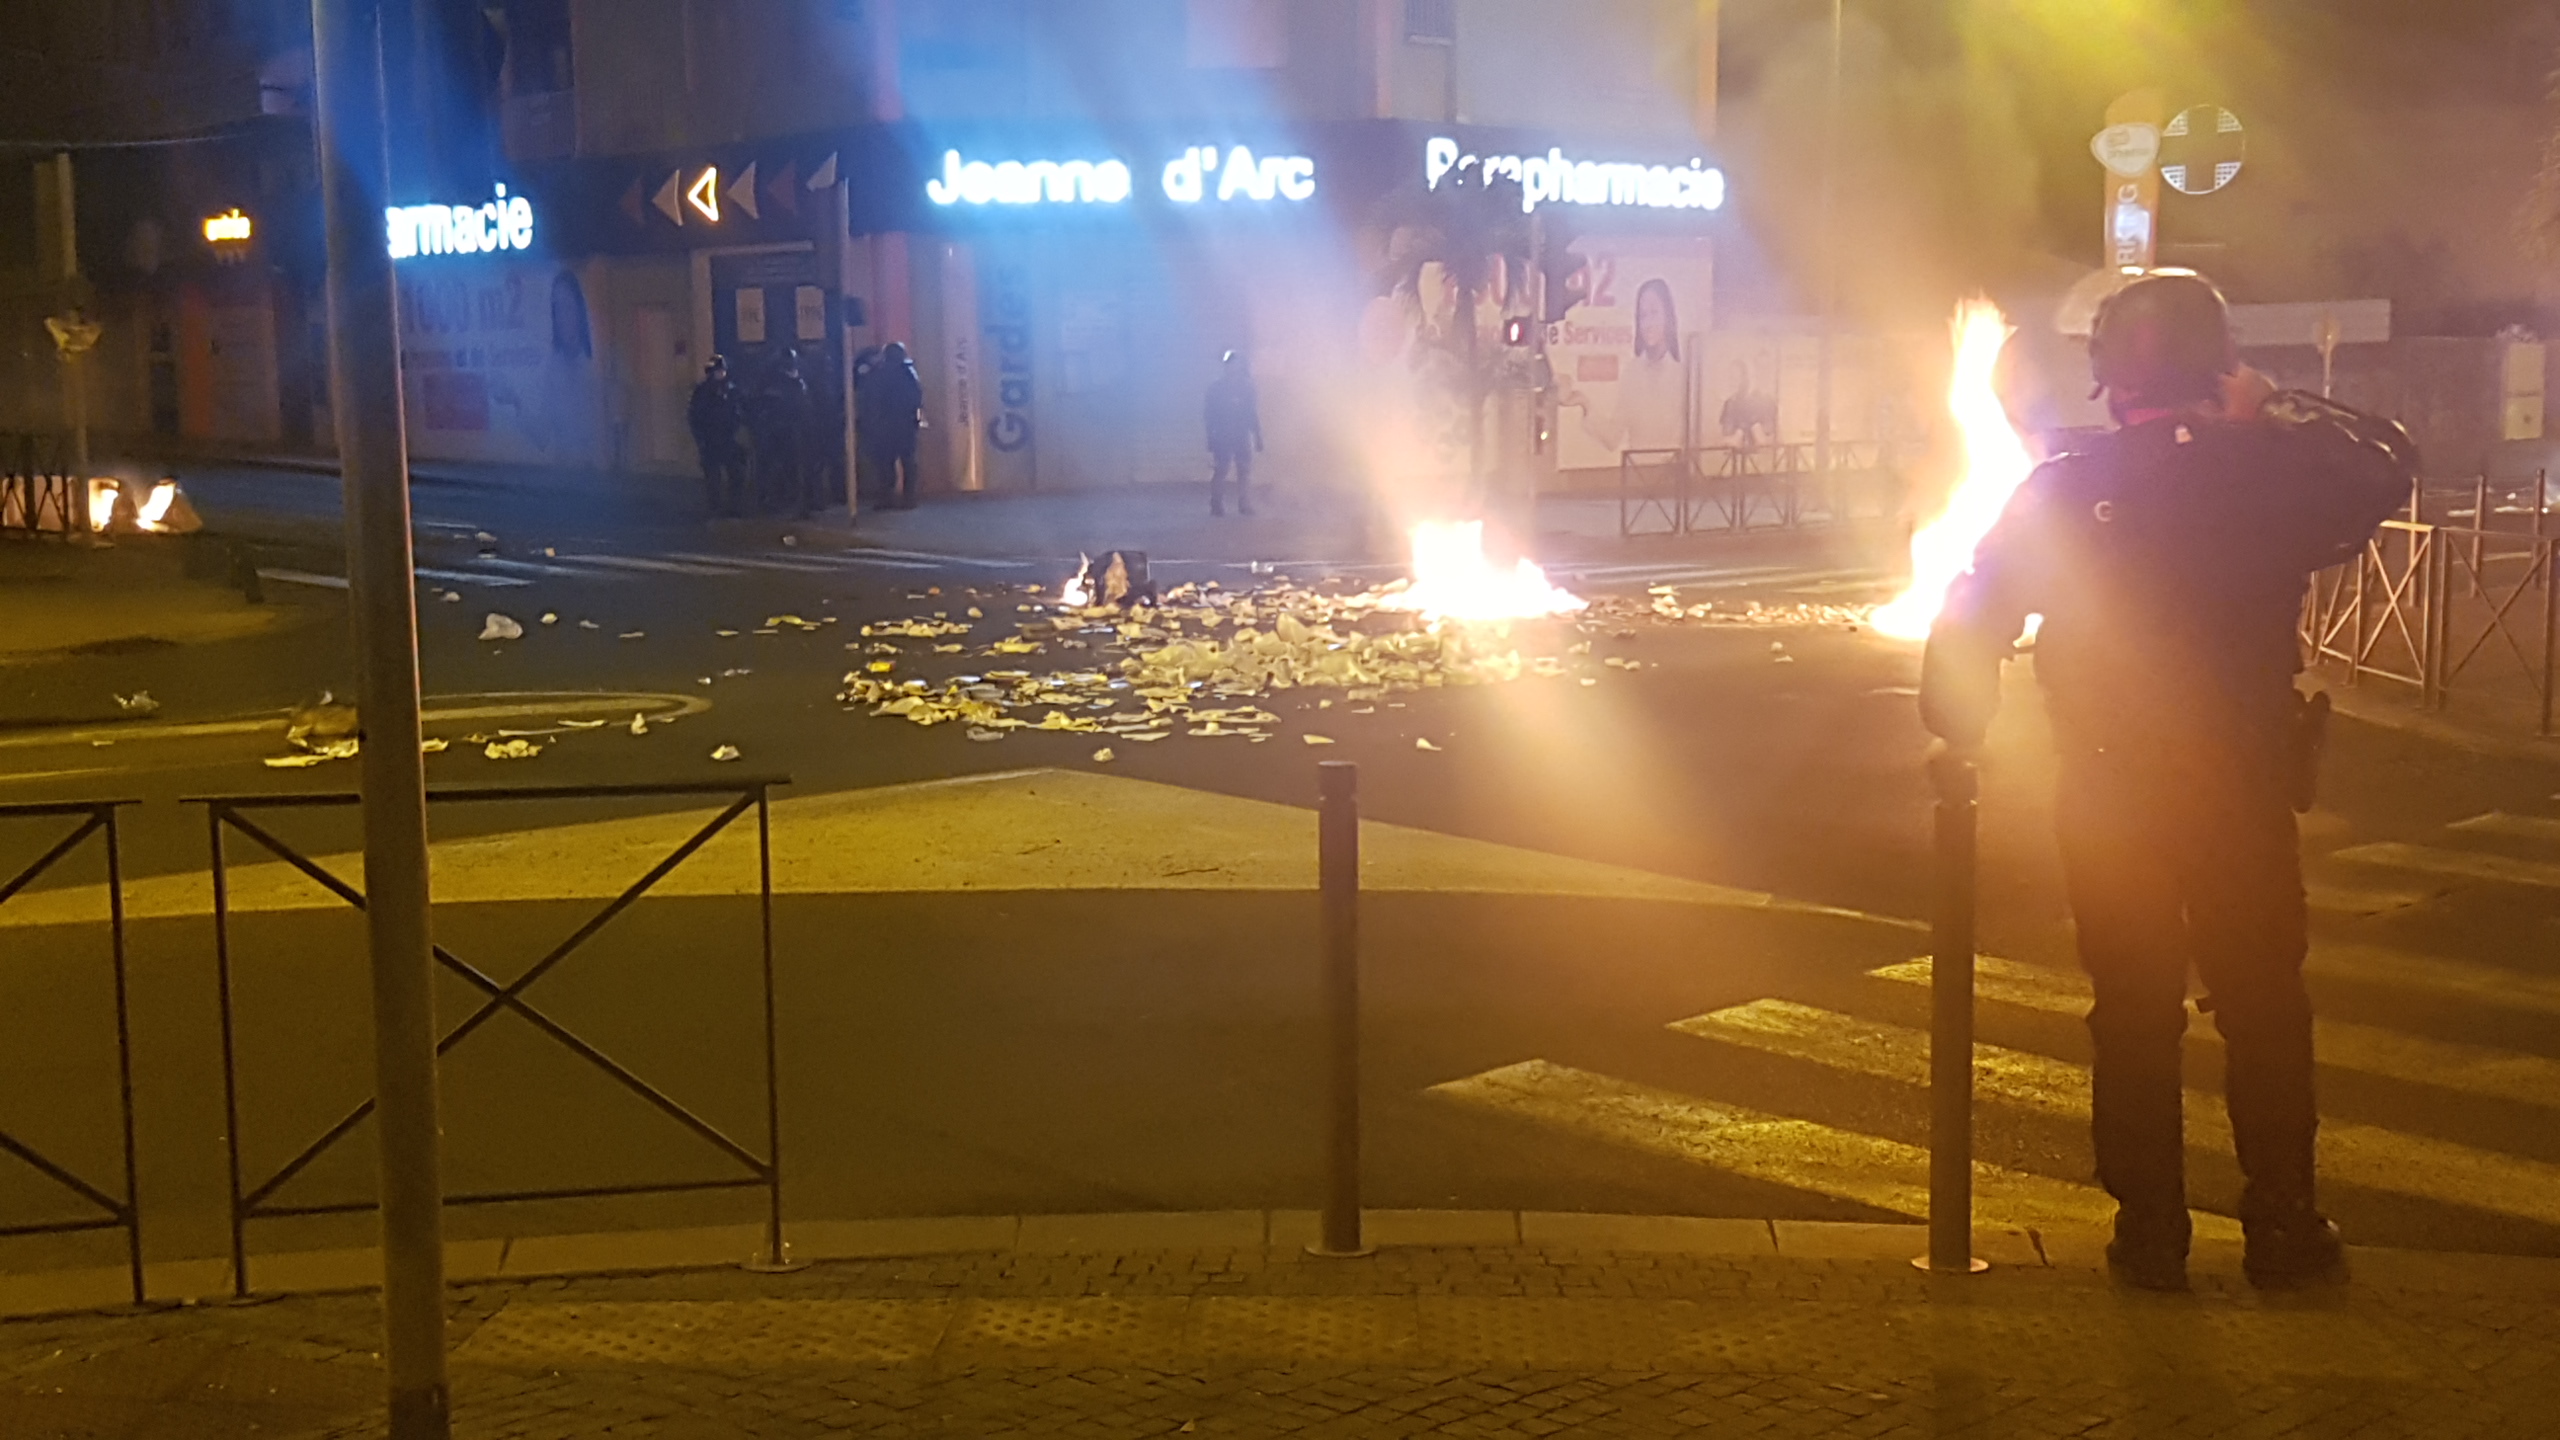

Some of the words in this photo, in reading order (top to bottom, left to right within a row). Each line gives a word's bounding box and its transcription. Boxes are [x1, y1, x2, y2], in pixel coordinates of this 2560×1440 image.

[926, 148, 1130, 205] Jeanne
[1162, 145, 1316, 202] d'Arc
[985, 264, 1031, 453] Gardes
